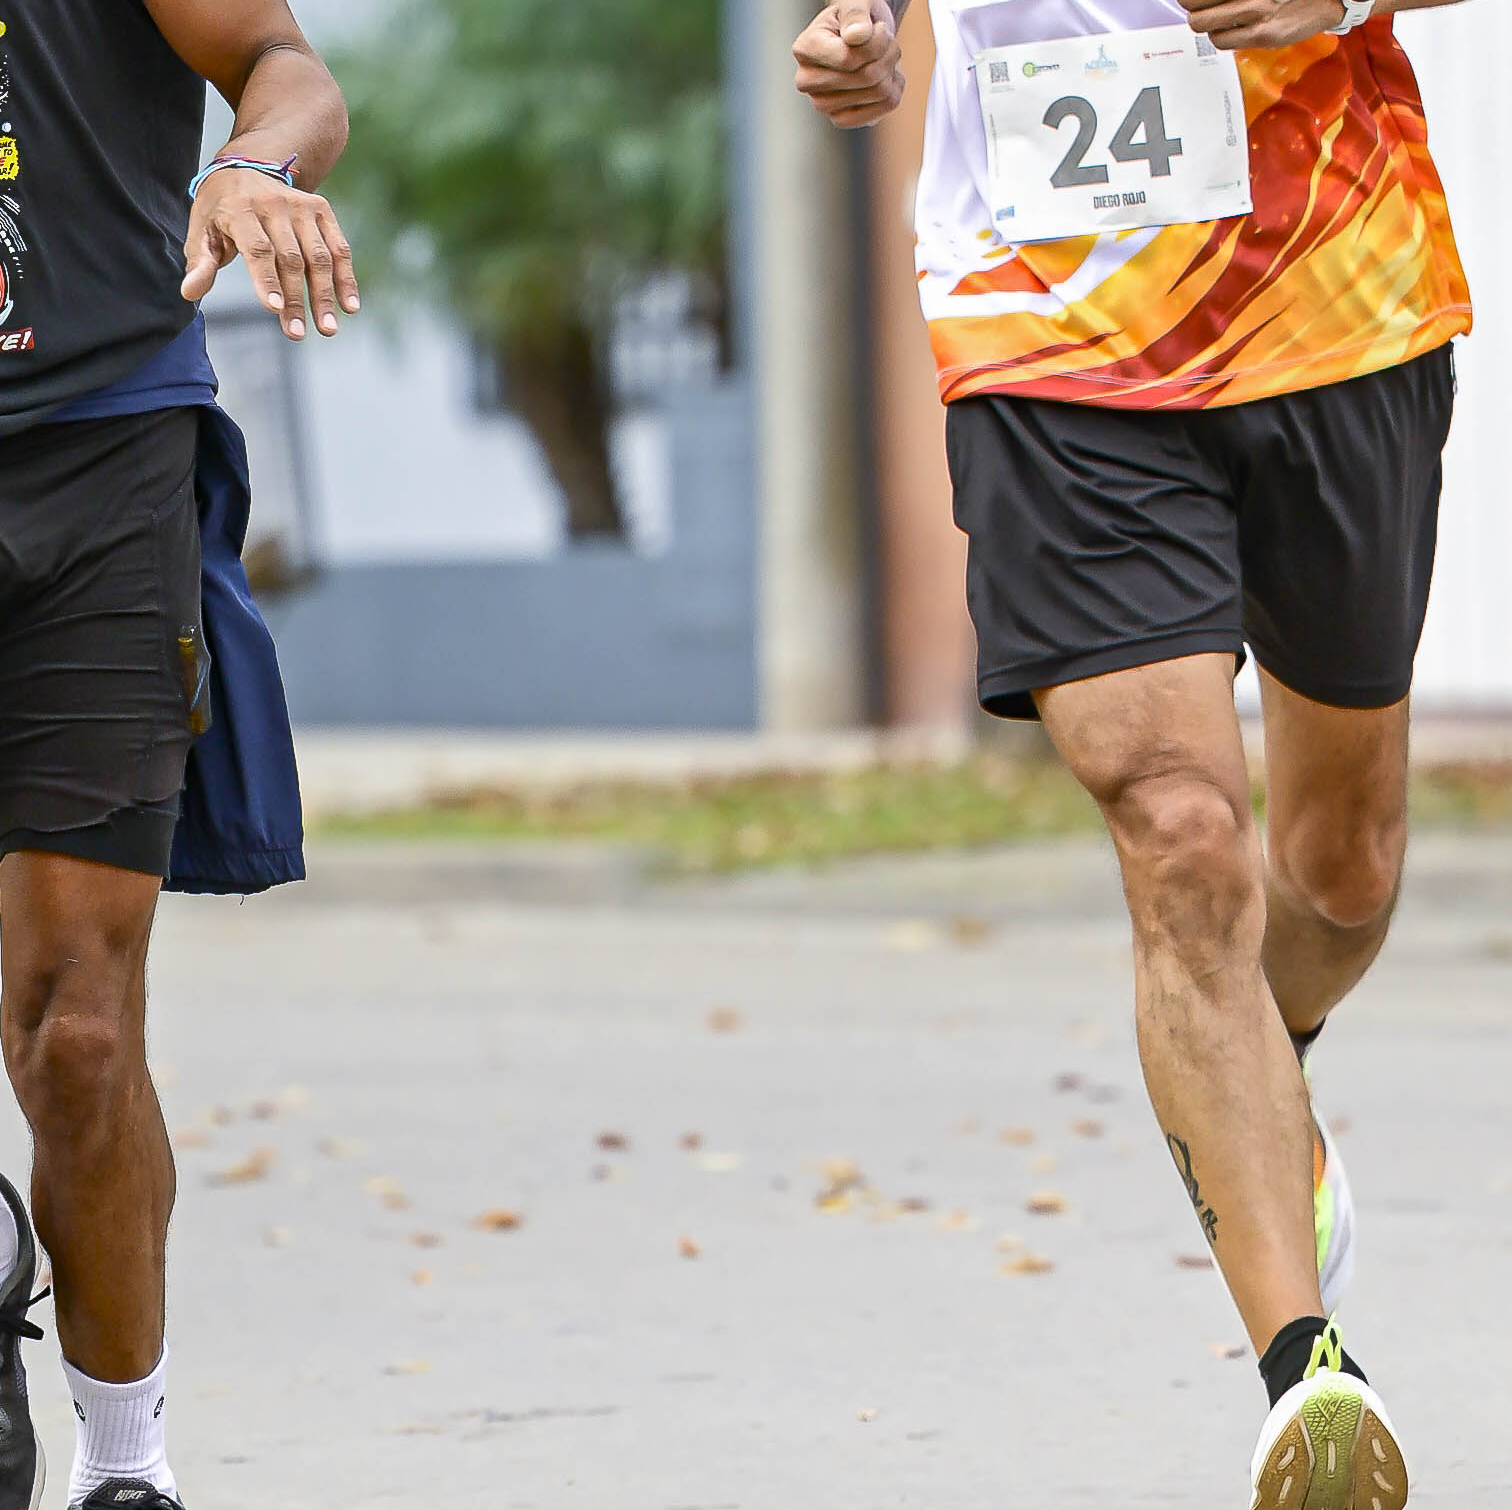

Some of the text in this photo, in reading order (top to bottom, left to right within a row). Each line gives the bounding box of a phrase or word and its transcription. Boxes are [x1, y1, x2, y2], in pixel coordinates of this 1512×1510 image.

[1042, 86, 1183, 189] 24
[3, 148, 13, 156] TO
[1093, 194, 1120, 209] DIEGO
[114, 1489, 147, 1502] NIKE
